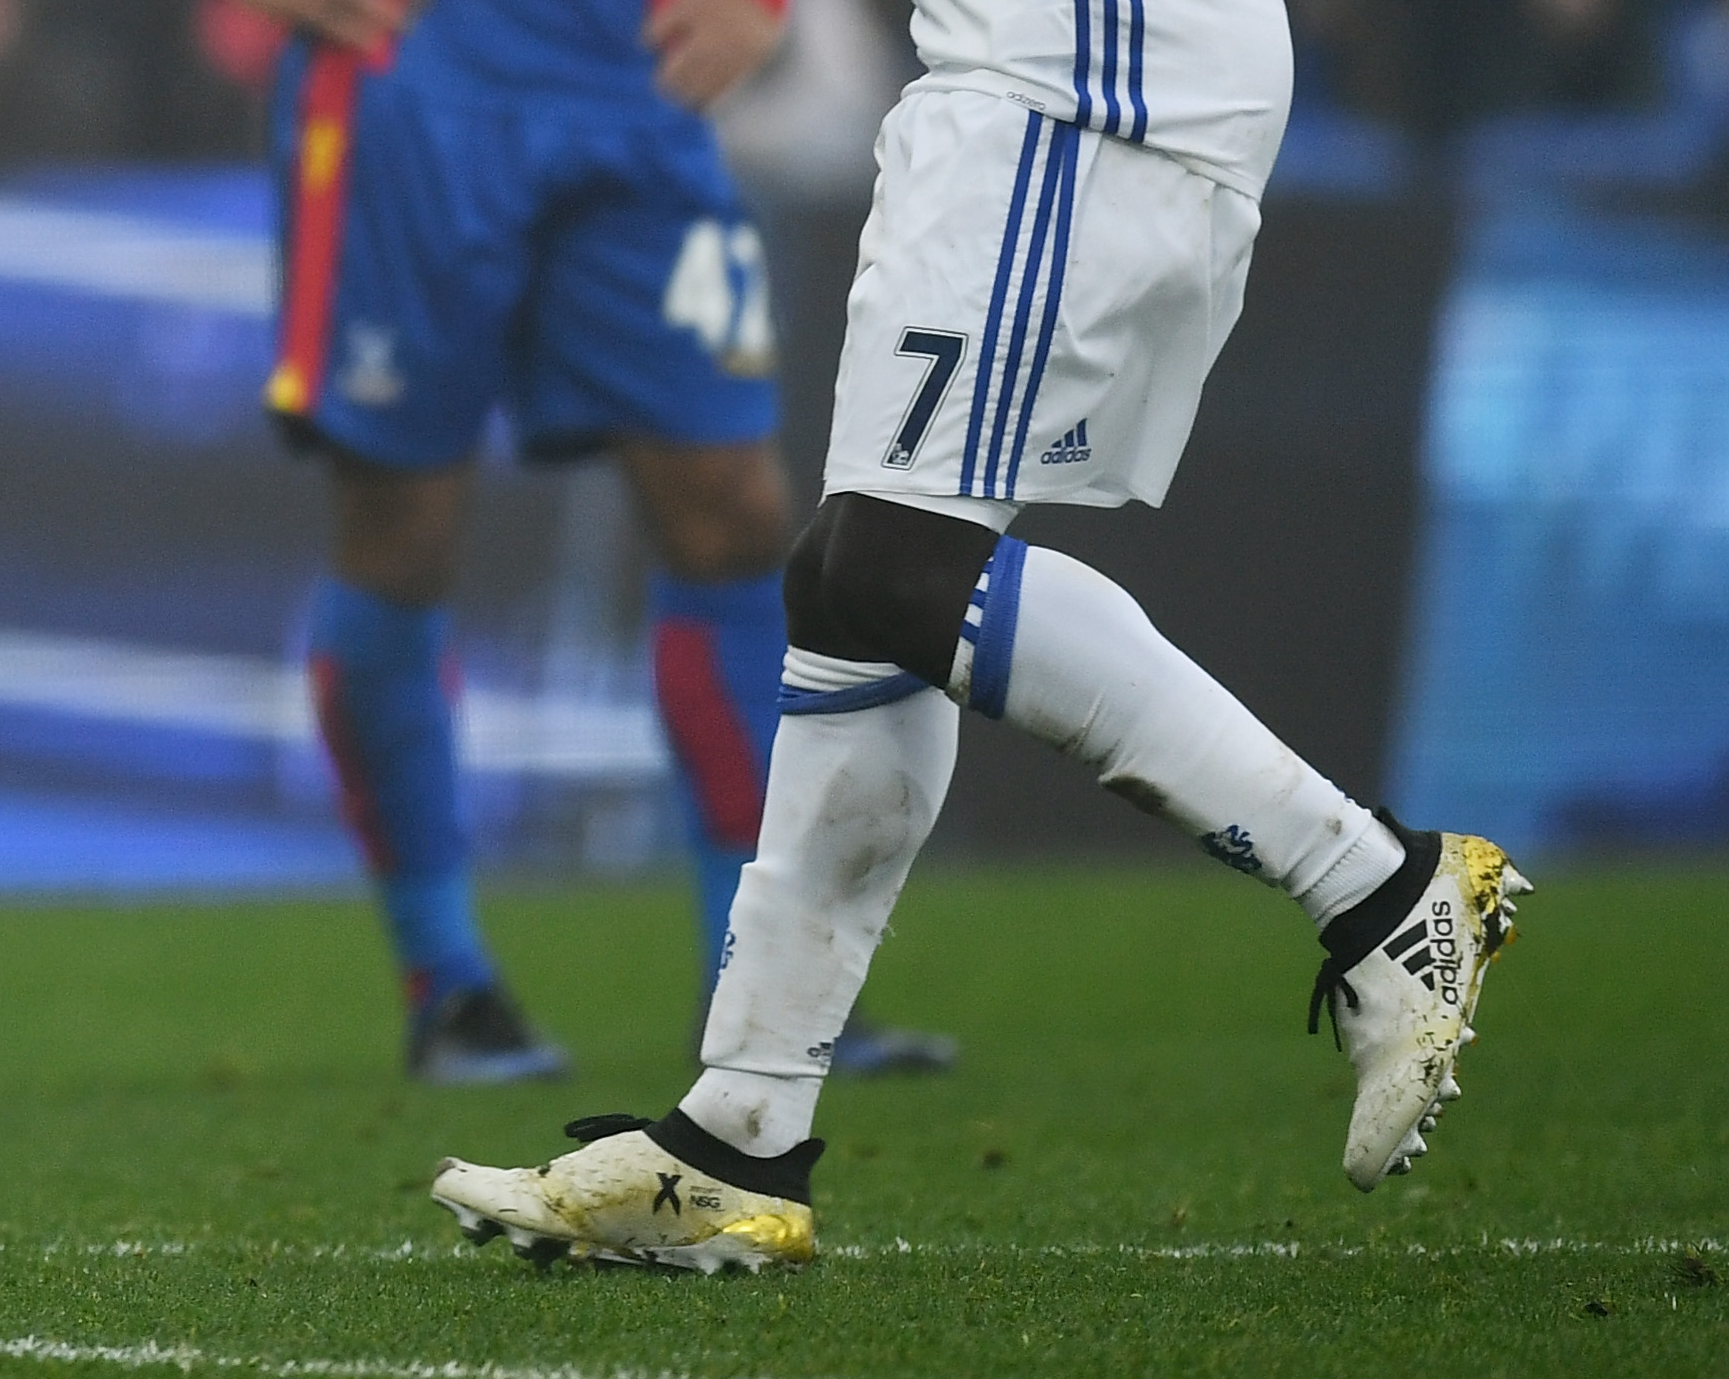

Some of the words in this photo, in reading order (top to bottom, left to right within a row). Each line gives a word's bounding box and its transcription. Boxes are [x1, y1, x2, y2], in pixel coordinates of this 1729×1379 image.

[881, 325, 969, 471] 7
[1040, 446, 1092, 465] adidas
[1431, 901, 1458, 1005] adidas
